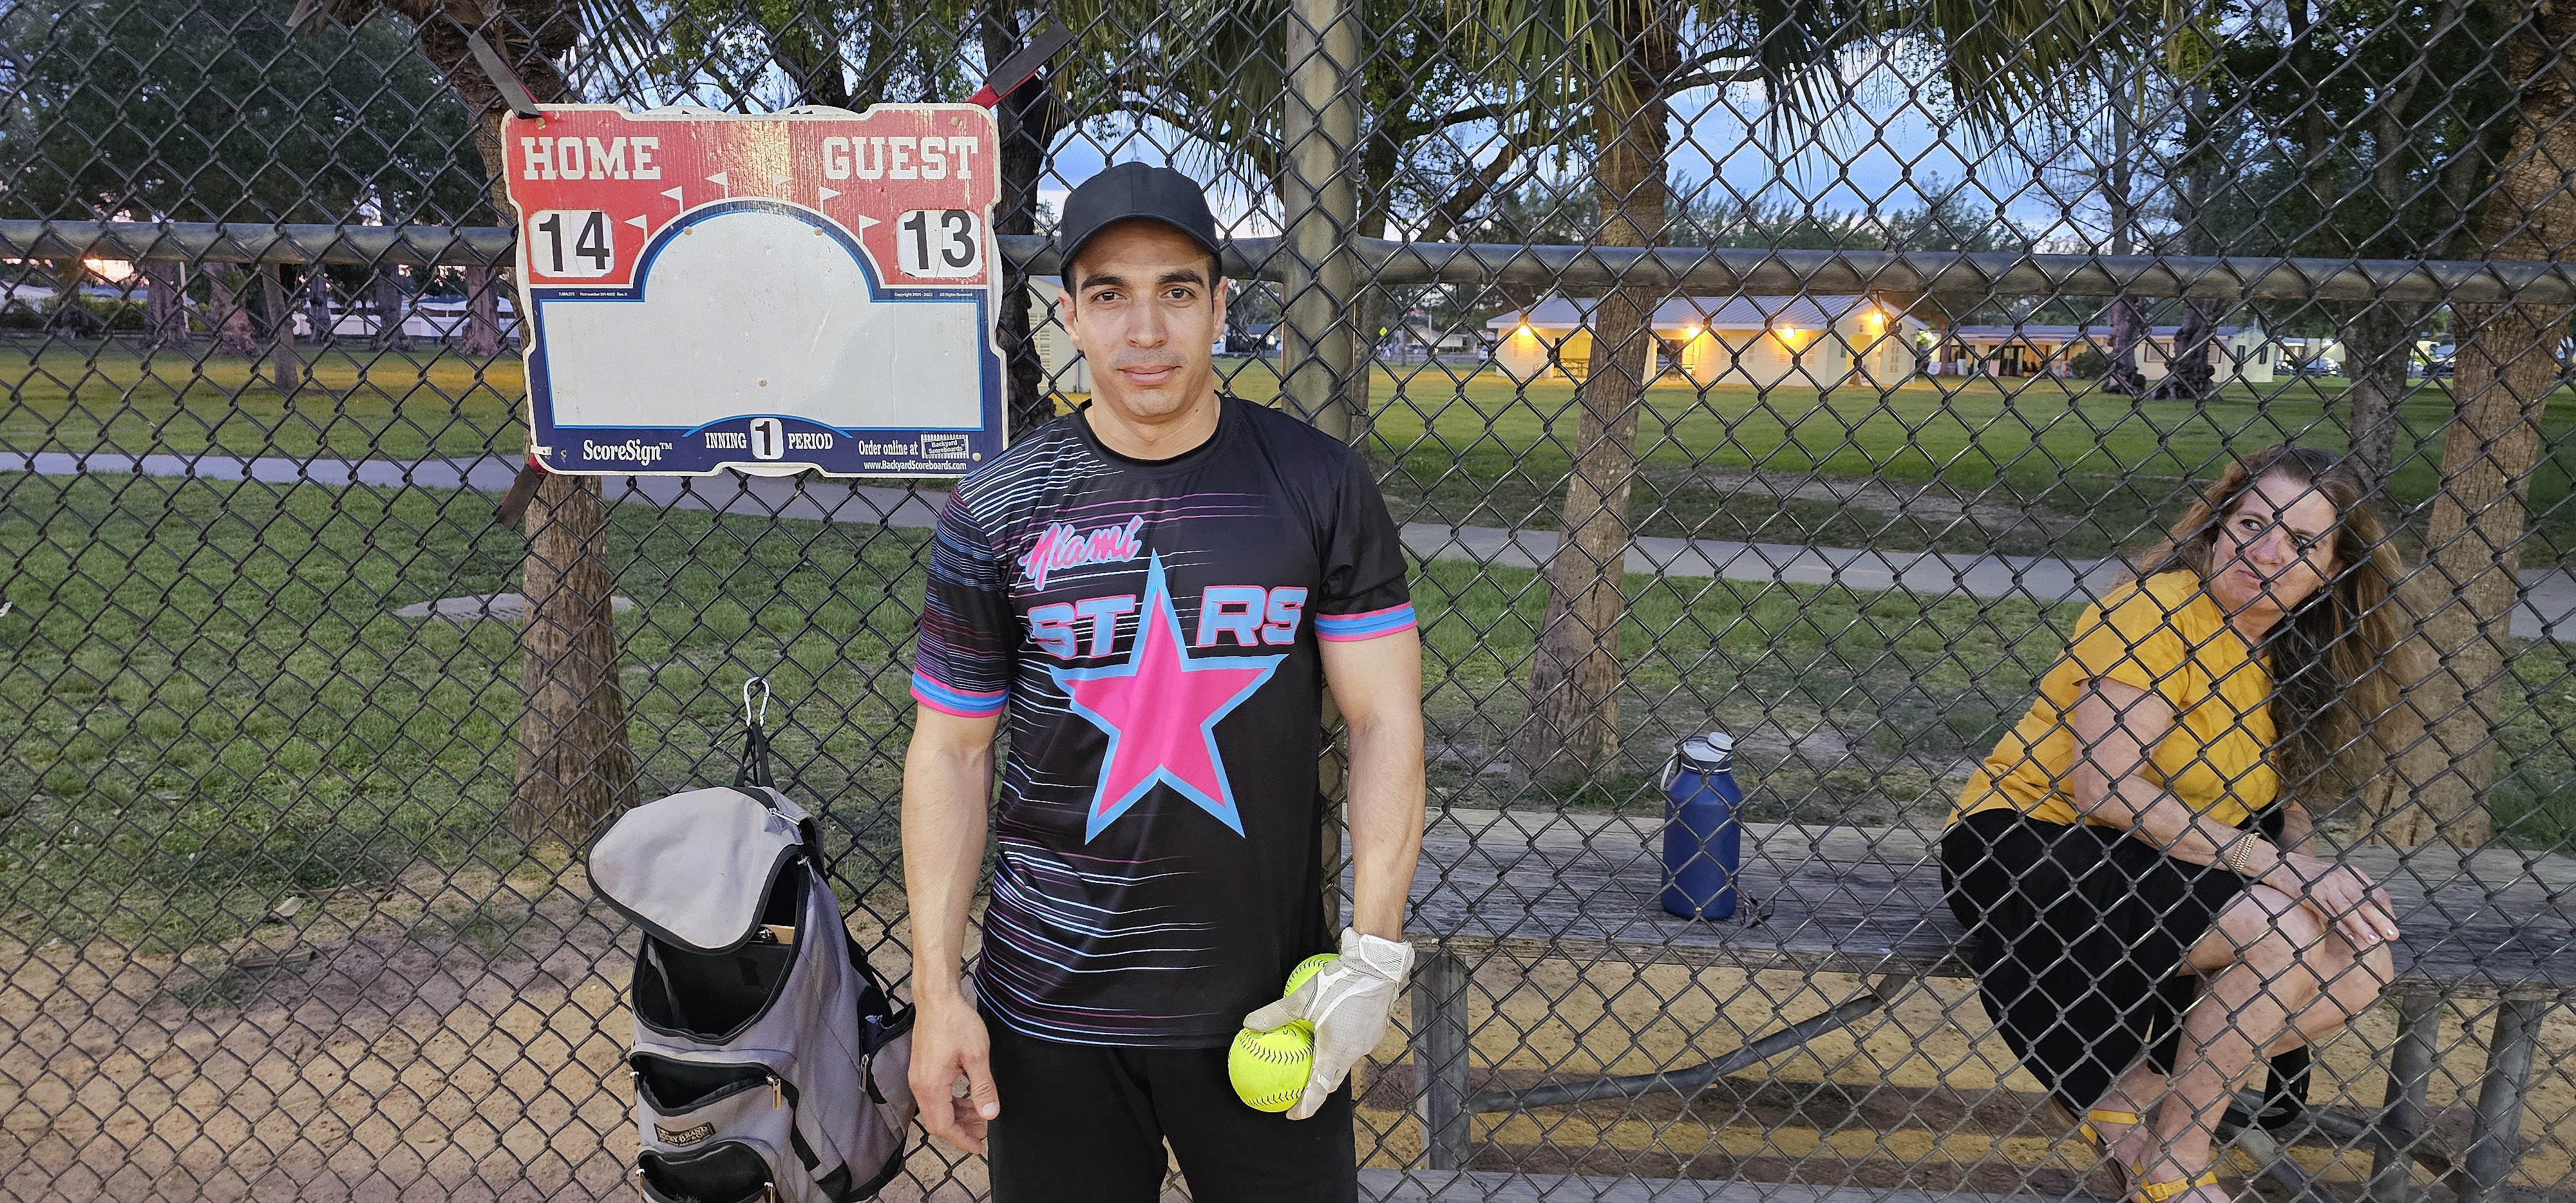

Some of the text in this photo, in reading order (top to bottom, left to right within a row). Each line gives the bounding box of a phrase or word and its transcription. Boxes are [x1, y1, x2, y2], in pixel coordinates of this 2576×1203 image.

[520, 137, 661, 180] HOME
[823, 137, 978, 180] GUEST
[538, 211, 611, 272] 14
[904, 209, 976, 270] 13
[705, 421, 833, 455] INNING 1 PERIOD
[858, 440, 918, 455] Order online at
[931, 440, 958, 448] Backyard
[864, 459, 967, 472] www.BackyardScoreboards.com
[1018, 515, 1144, 591] Miami
